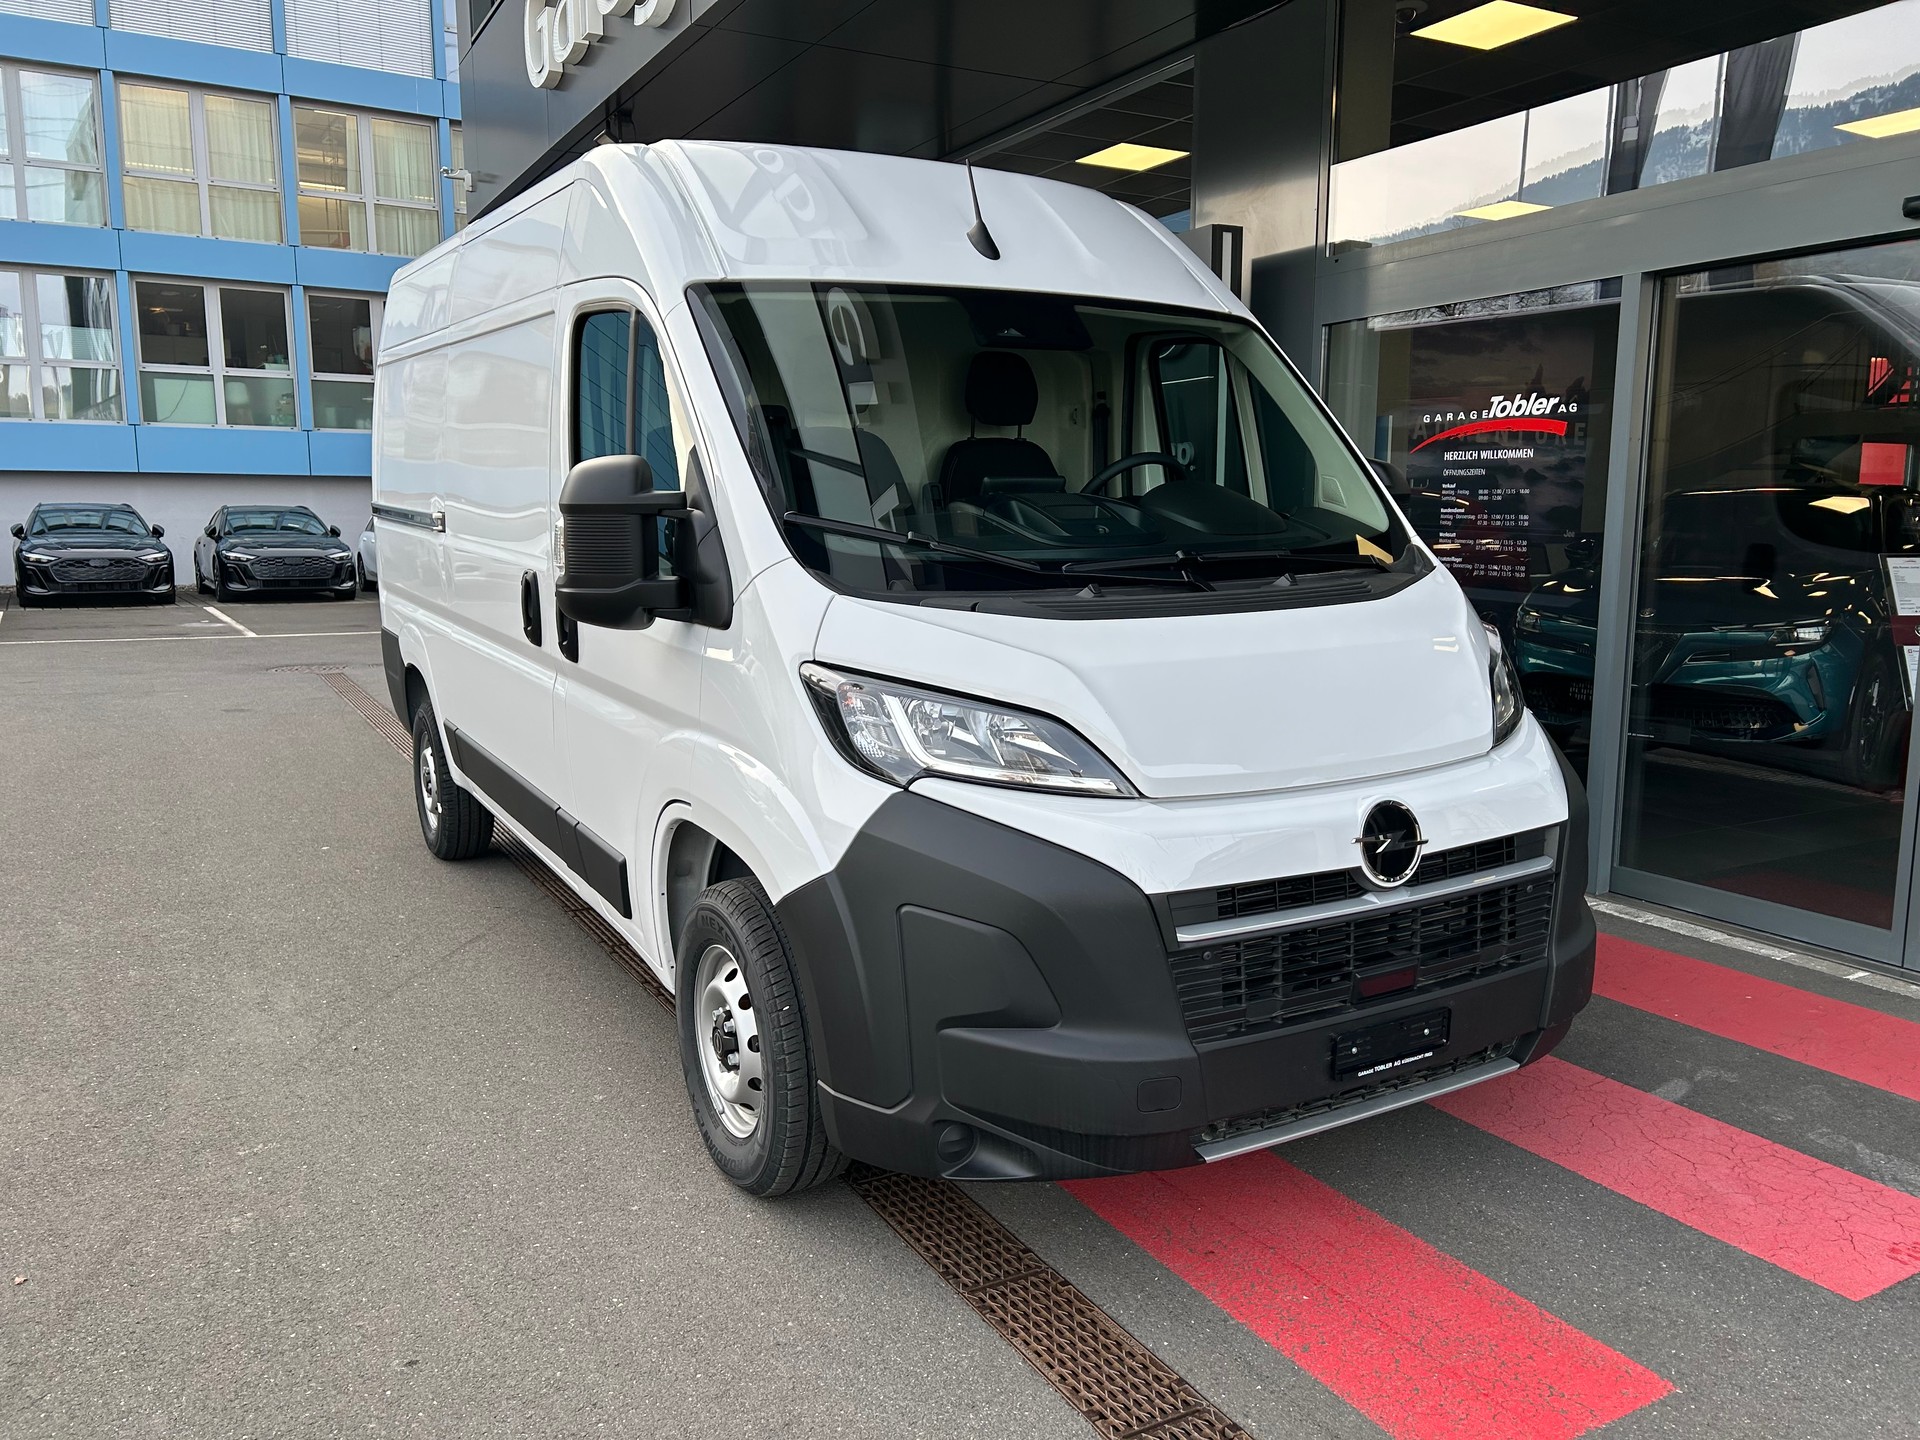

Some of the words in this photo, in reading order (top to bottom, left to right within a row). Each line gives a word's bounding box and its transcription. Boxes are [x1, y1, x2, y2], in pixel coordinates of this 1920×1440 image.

[1423, 409, 1489, 423] GARAGE
[1488, 392, 1561, 419] Tobler
[1557, 402, 1578, 414] AG
[1444, 450, 1478, 461] HERZLICH
[1480, 448, 1534, 460] WILLKOMMEN
[1442, 467, 1486, 477] ÖFFNUNGSZEITEN
[1357, 1068, 1374, 1077] GARAGE
[1374, 1062, 1392, 1072] TOBLER
[1393, 1059, 1402, 1067] AG
